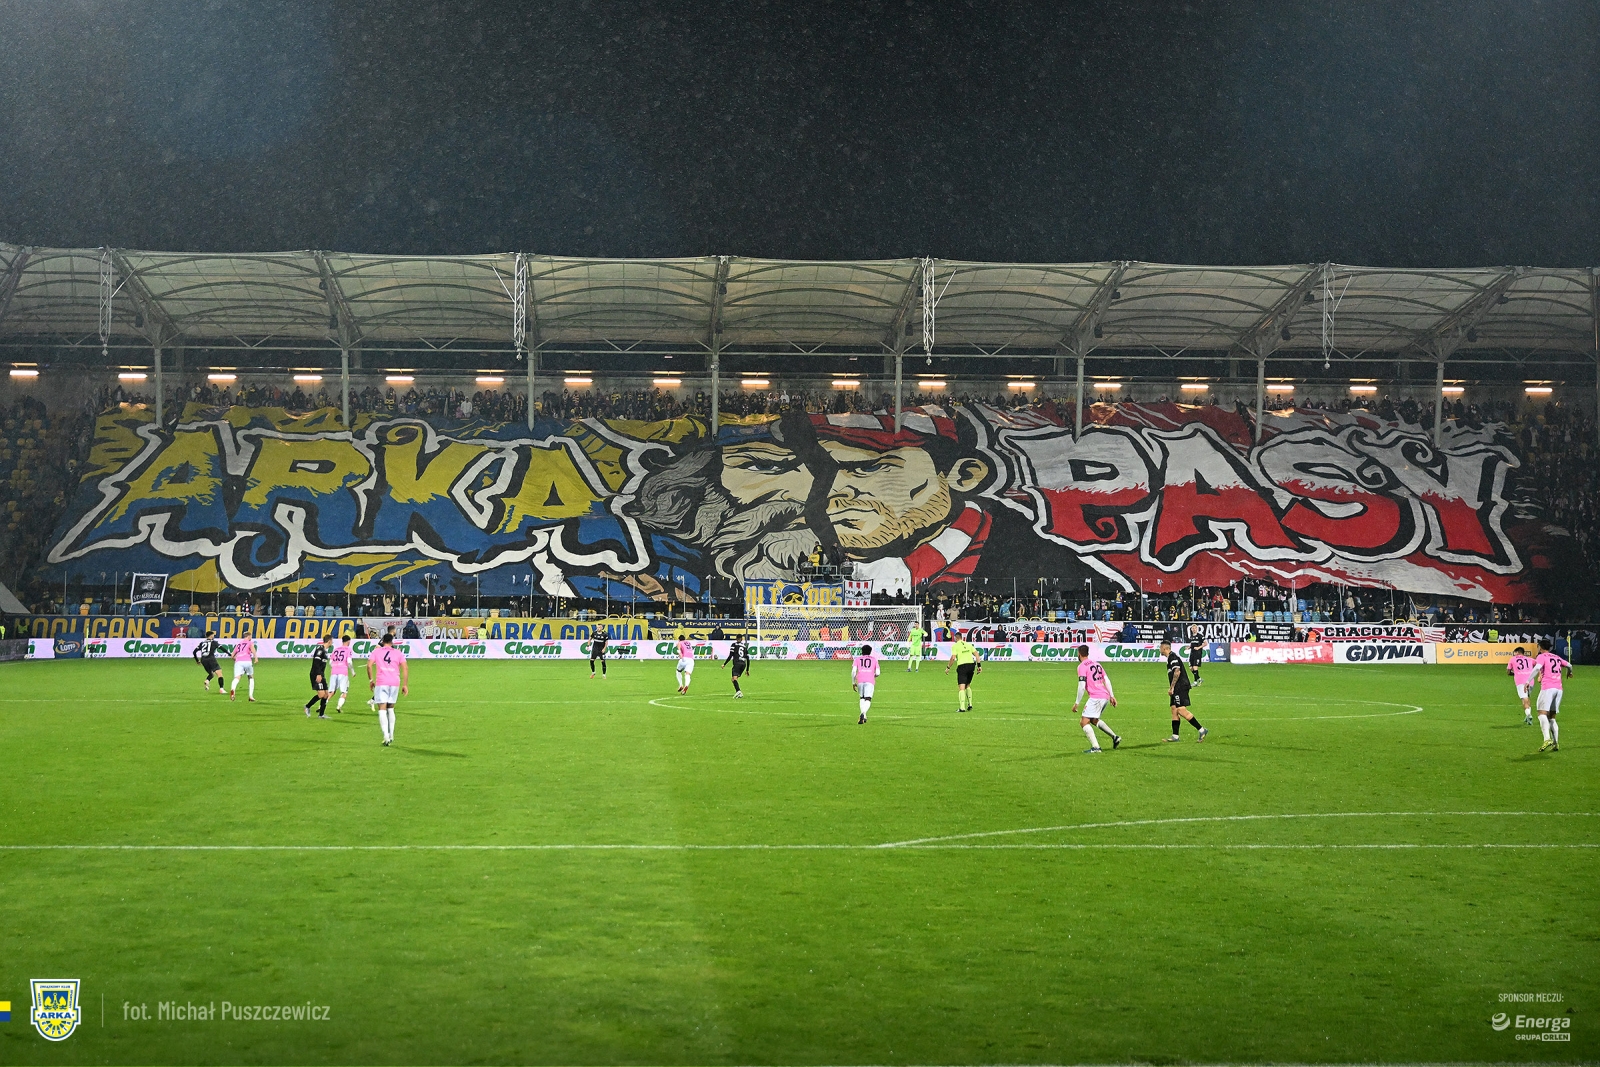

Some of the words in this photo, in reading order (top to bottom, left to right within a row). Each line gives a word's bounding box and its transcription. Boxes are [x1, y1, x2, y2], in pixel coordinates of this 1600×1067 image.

[60, 421, 645, 576] ARKA
[1003, 425, 1515, 572] PASY
[206, 617, 276, 638] FROM
[491, 622, 552, 640] ARKA
[1324, 626, 1416, 637] CRACOVIA
[124, 638, 181, 653] Clovin
[201, 642, 211, 653] 21
[428, 640, 487, 654] Clovin
[505, 641, 562, 655] Clovin
[738, 647, 744, 657] 6
[1105, 645, 1160, 658] Clovin
[333, 650, 345, 662] 35
[383, 651, 391, 664] 4
[1238, 645, 1323, 661] SUPERBET
[1346, 645, 1423, 661] GDYNIA
[1458, 649, 1489, 659] Energa
[860, 658, 871, 668] 10
[1516, 658, 1529, 670] 31
